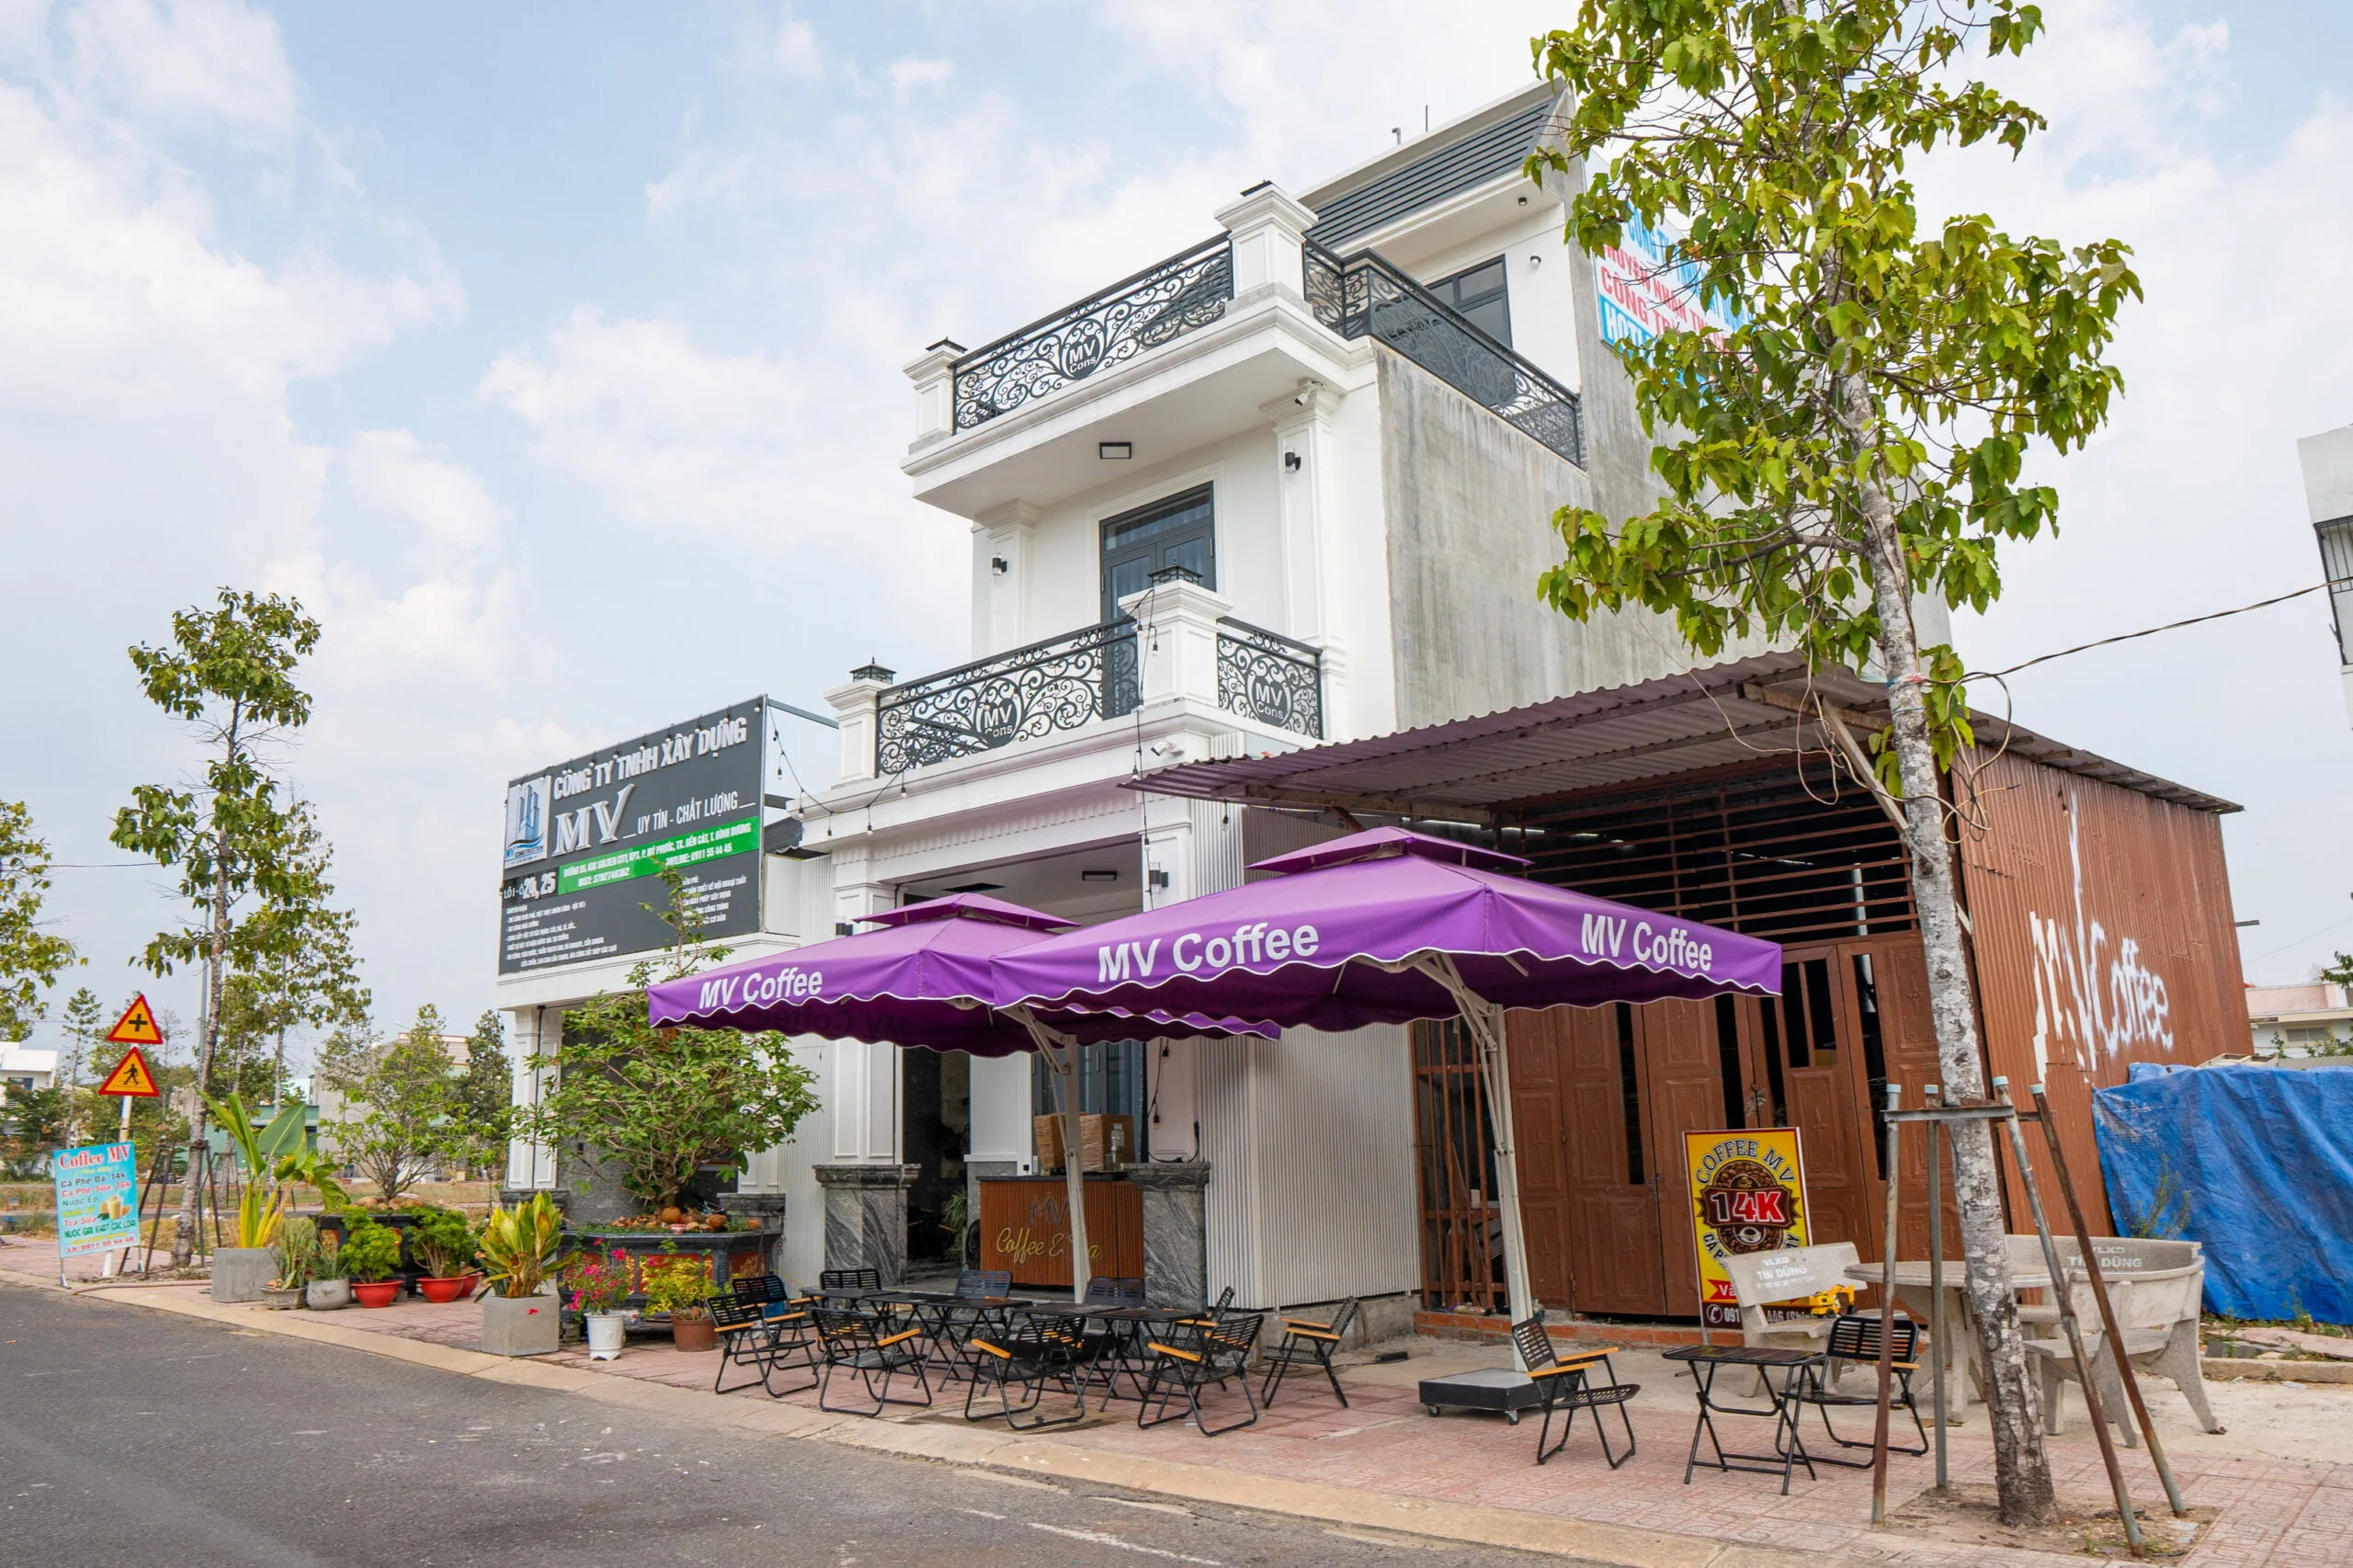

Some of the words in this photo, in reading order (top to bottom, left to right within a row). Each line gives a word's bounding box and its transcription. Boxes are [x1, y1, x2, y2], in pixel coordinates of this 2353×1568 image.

[1070, 339, 1097, 364] MV
[1070, 357, 1097, 373] Cons
[1256, 682, 1282, 707] MV
[1256, 701, 1284, 720] Cons
[984, 704, 1013, 728] MV
[553, 768, 593, 801] CÔNG
[594, 759, 615, 789] TY
[617, 745, 659, 780] TNHH
[660, 733, 696, 767] XÂY
[698, 717, 747, 757] DỰNG
[551, 783, 636, 858] MV
[638, 814, 652, 835] UY
[653, 809, 668, 831] TÍN
[676, 797, 702, 824] CHẤT
[704, 790, 739, 817] LƯỢNG
[540, 871, 557, 895] 25
[1098, 938, 1162, 983] MV
[1173, 922, 1319, 971] Coffee
[1581, 913, 1627, 958] MV
[1633, 921, 1712, 971] Coffee
[699, 976, 740, 1009] MV
[743, 967, 823, 1003] Coffee
[59, 1150, 104, 1169] Coffee
[107, 1144, 131, 1164] MV
[1696, 1139, 1759, 1185] COFFEE
[1711, 1192, 1786, 1222] 14K
[996, 1227, 1045, 1264] Coffee
